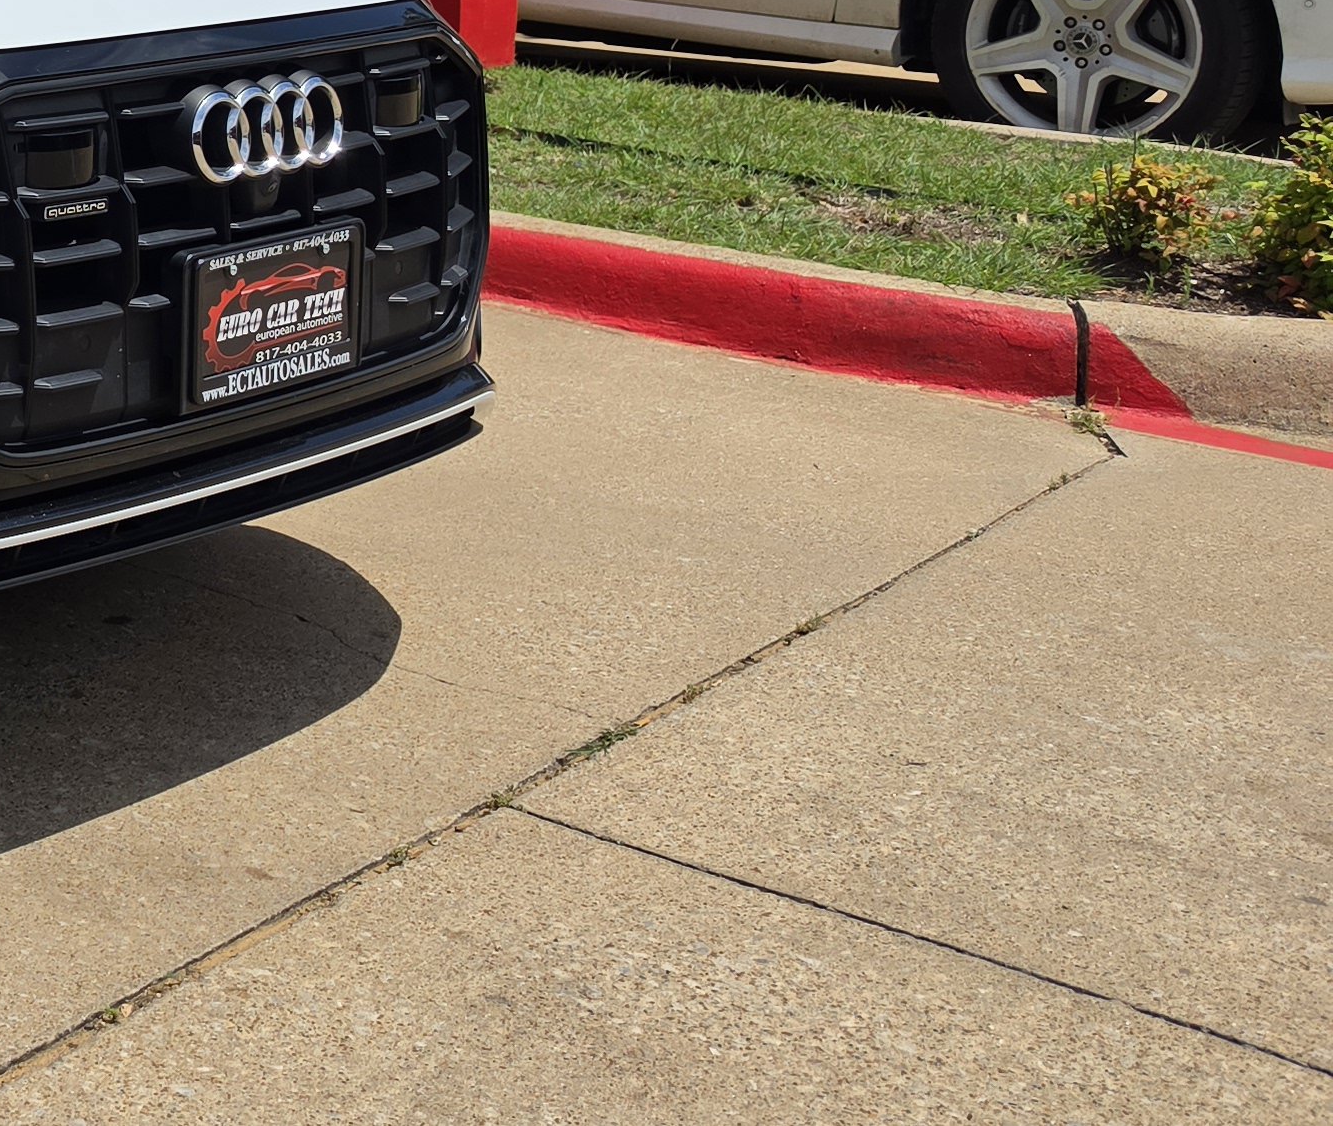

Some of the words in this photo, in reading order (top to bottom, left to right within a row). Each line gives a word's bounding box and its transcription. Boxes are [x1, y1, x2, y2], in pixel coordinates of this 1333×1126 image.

[48, 202, 106, 217] quattro
[209, 255, 236, 270] SALES
[236, 253, 245, 264] &
[245, 244, 284, 262] SERVICE
[293, 229, 350, 252] 817-404-4033
[217, 308, 263, 342] EURO
[266, 298, 300, 329] CAR
[303, 287, 346, 320] TECH
[255, 324, 295, 342] european
[296, 312, 343, 332] automotive
[255, 331, 342, 363] 817-404-4033
[201, 348, 351, 403] www.ECTAUTOSALES.com
